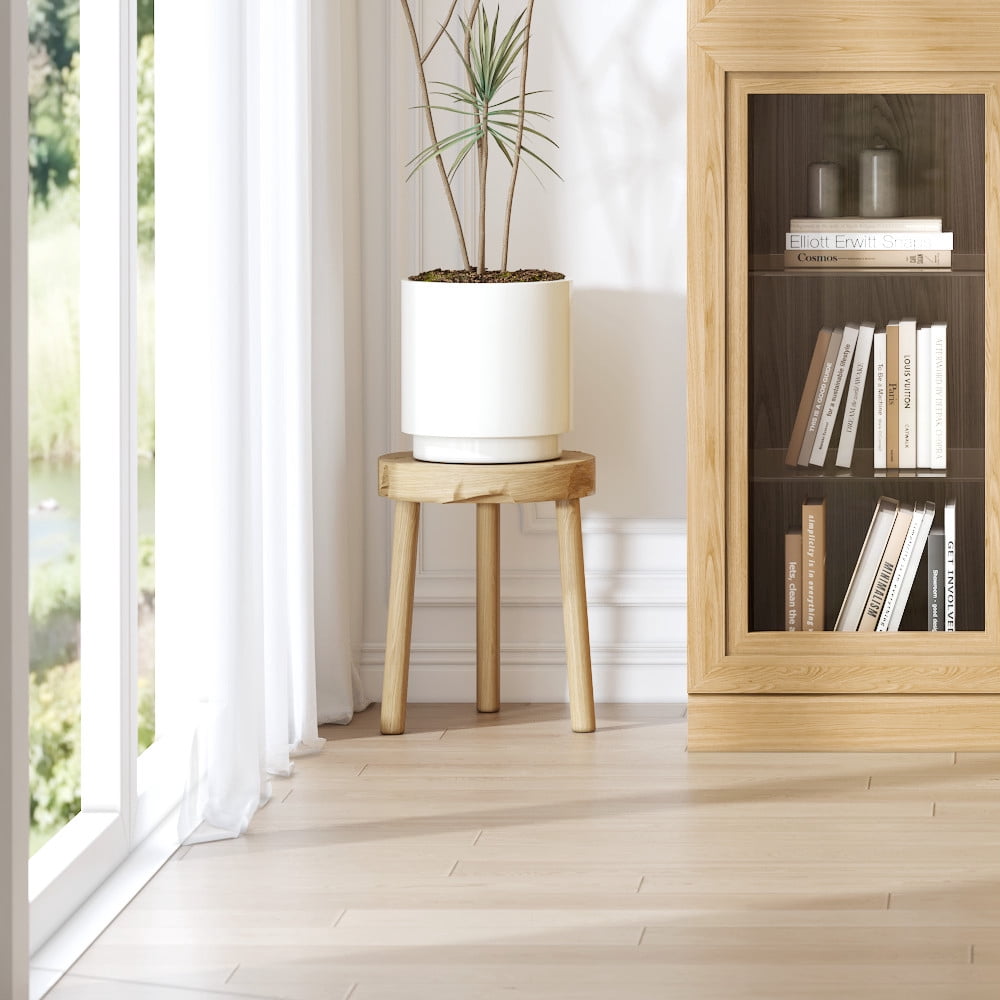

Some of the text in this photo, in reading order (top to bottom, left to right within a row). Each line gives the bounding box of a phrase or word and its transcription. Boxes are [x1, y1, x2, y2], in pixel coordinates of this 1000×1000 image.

[790, 234, 829, 249] Elliott
[835, 234, 877, 249] Erwitt
[797, 253, 838, 262] Cosmos
[830, 367, 844, 402] sustainable
[878, 372, 884, 381] Be
[877, 388, 885, 415] Machine
[889, 383, 898, 405] Paris
[807, 514, 815, 557] simplicity
[808, 559, 815, 567] is
[808, 569, 815, 577] in
[789, 583, 797, 606] clean
[867, 561, 894, 618] MINIMALISM
[807, 580, 815, 625] everything
[789, 609, 797, 624] the
